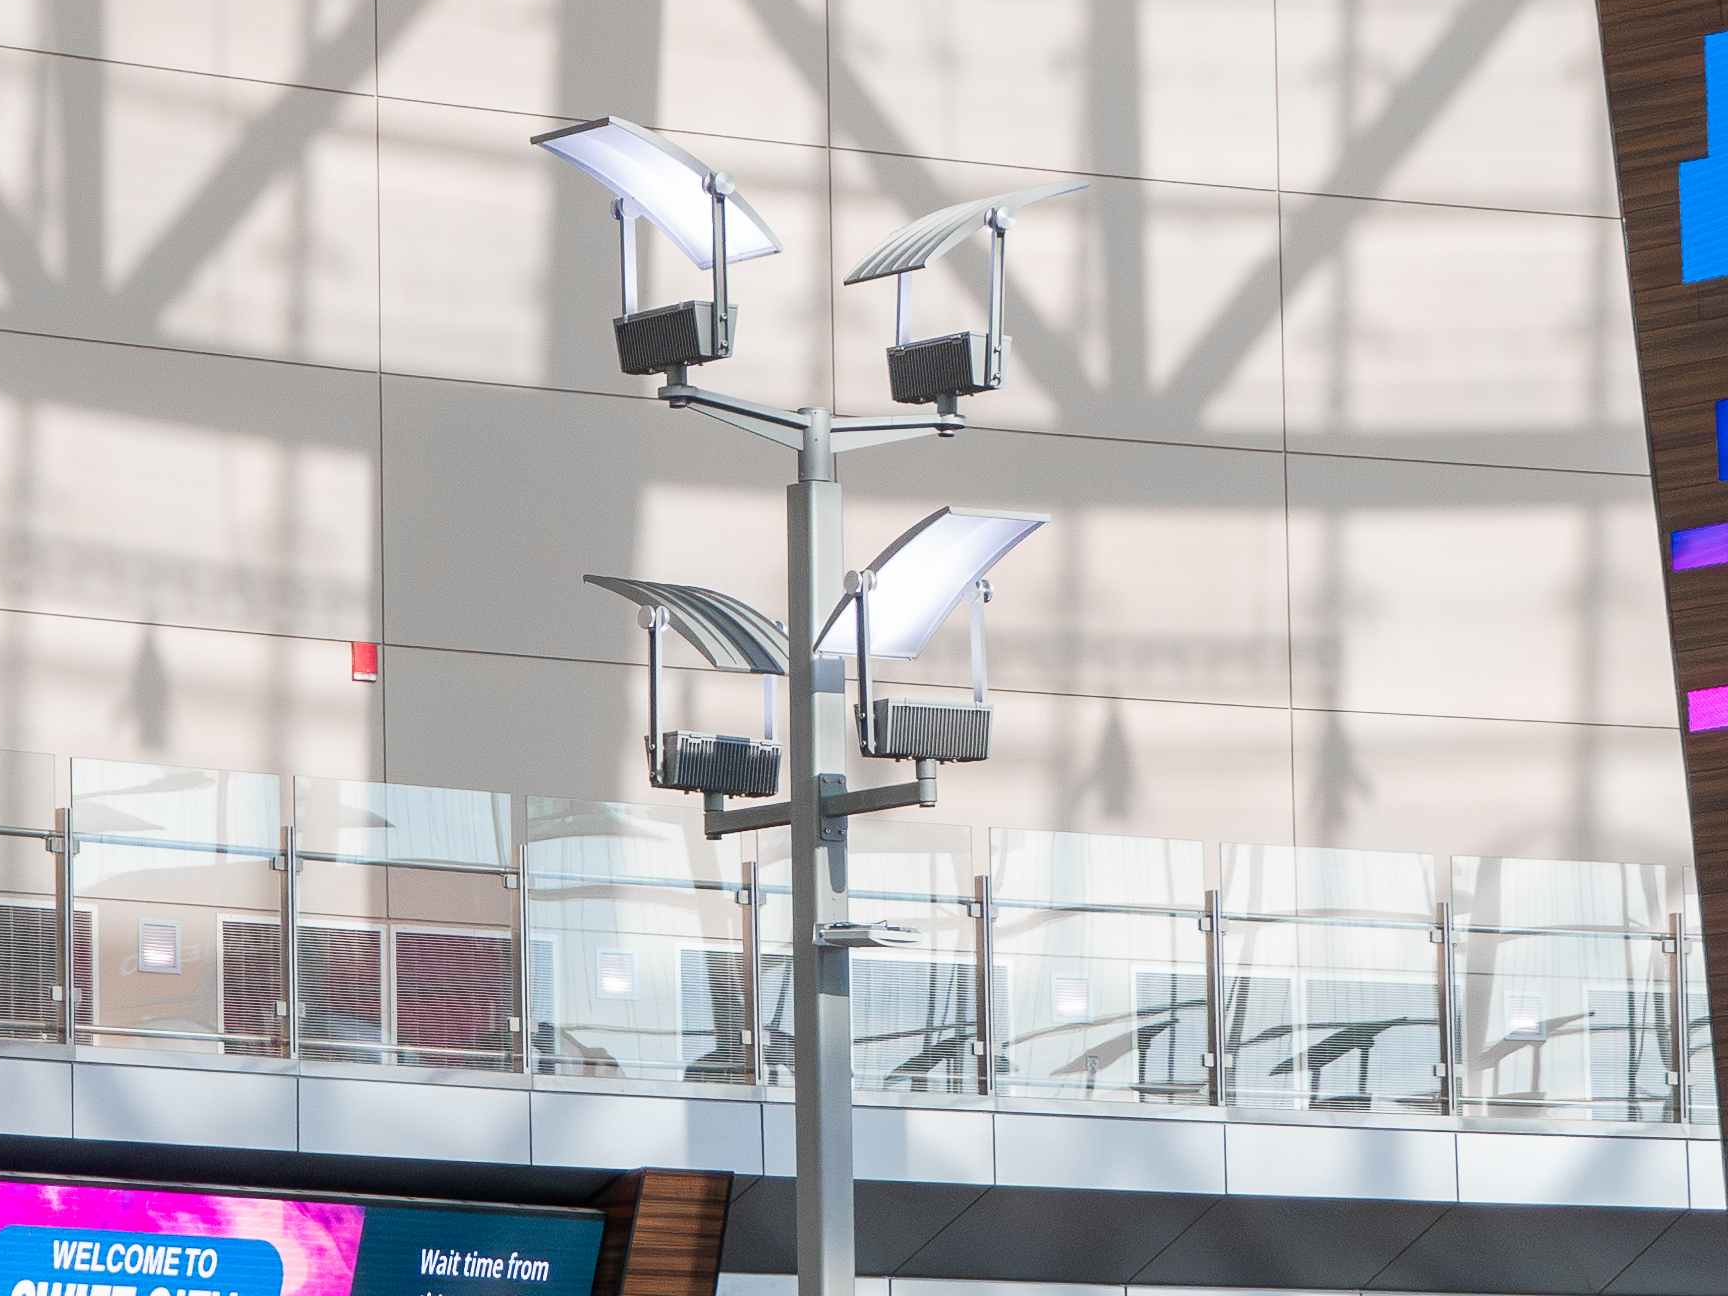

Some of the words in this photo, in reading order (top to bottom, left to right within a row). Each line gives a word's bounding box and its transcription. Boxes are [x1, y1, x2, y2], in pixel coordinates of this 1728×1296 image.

[52, 1241, 180, 1277] WELCOME
[184, 1246, 219, 1279] TO
[419, 1248, 458, 1277] Wait
[462, 1251, 503, 1280] time
[506, 1254, 550, 1282] from
